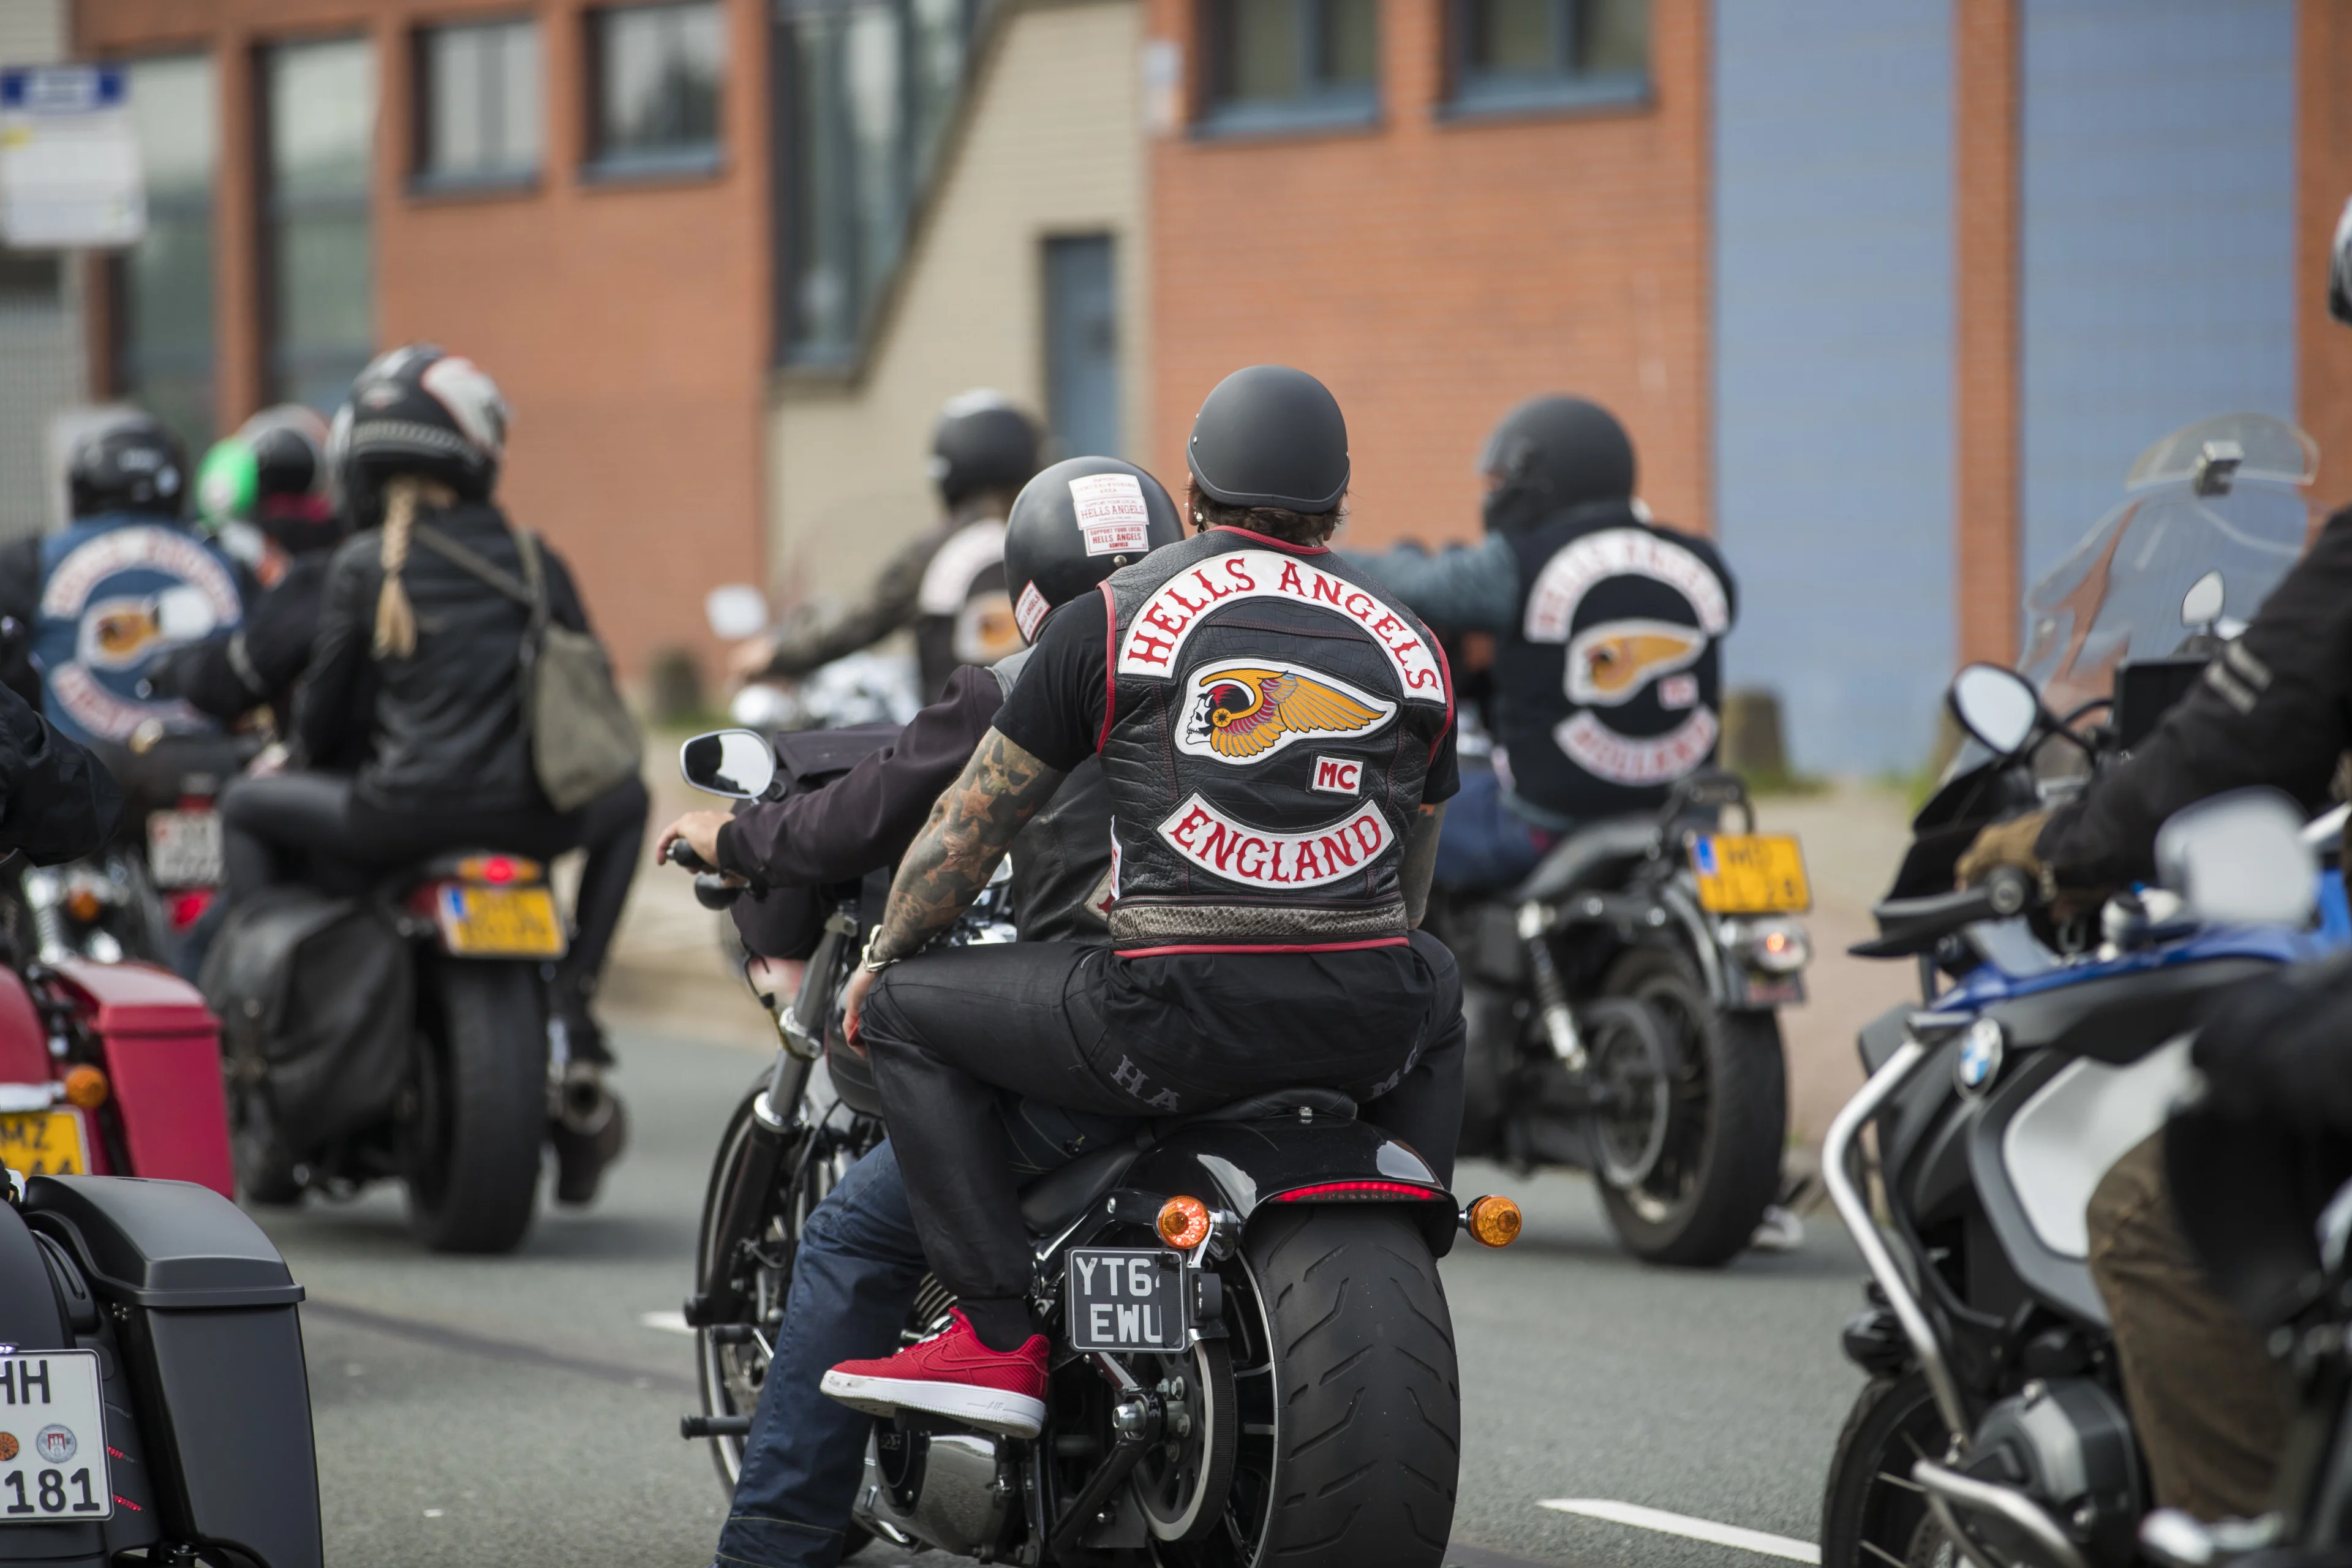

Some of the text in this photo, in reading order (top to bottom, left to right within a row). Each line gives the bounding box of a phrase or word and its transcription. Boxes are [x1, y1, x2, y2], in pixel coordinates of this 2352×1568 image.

[1080, 505, 1145, 520] HELLS ANGELS
[1092, 534, 1114, 544] HELLS
[1026, 594, 1040, 616] ANGELS
[1128, 557, 1256, 668] HELLS
[1277, 560, 1439, 695] ANGELS
[1319, 761, 1359, 791] MC
[1169, 804, 1382, 884] ENGLAND
[1076, 1257, 1161, 1297] YT6
[1090, 1303, 1163, 1343] EWU
[987, 1401, 1005, 1411] AIR
[5, 1468, 100, 1513] 181
